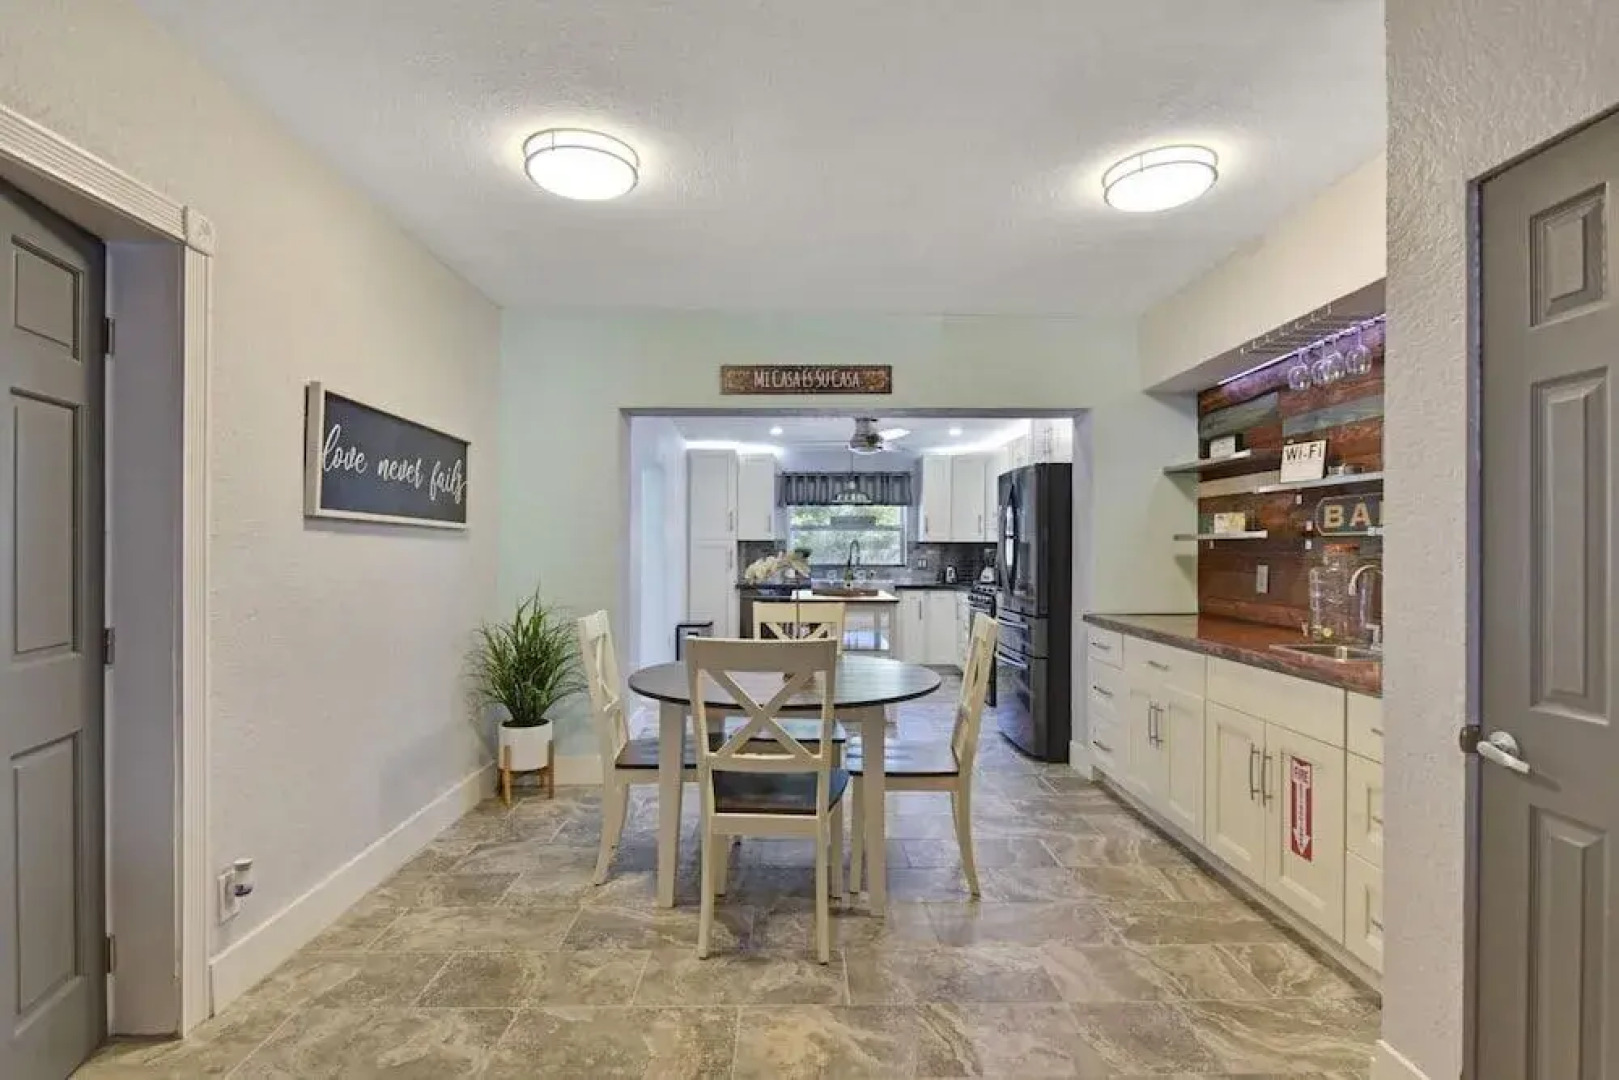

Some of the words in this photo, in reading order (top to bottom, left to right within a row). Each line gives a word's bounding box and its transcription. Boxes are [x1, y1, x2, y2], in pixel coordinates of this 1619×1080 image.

[754, 370, 770, 388] MI
[772, 370, 800, 388] CASA
[815, 370, 830, 388] SU
[833, 370, 860, 388] CASA
[323, 424, 368, 473] love
[378, 458, 423, 490] never
[429, 458, 468, 504] fails
[1324, 502, 1382, 529] BA
